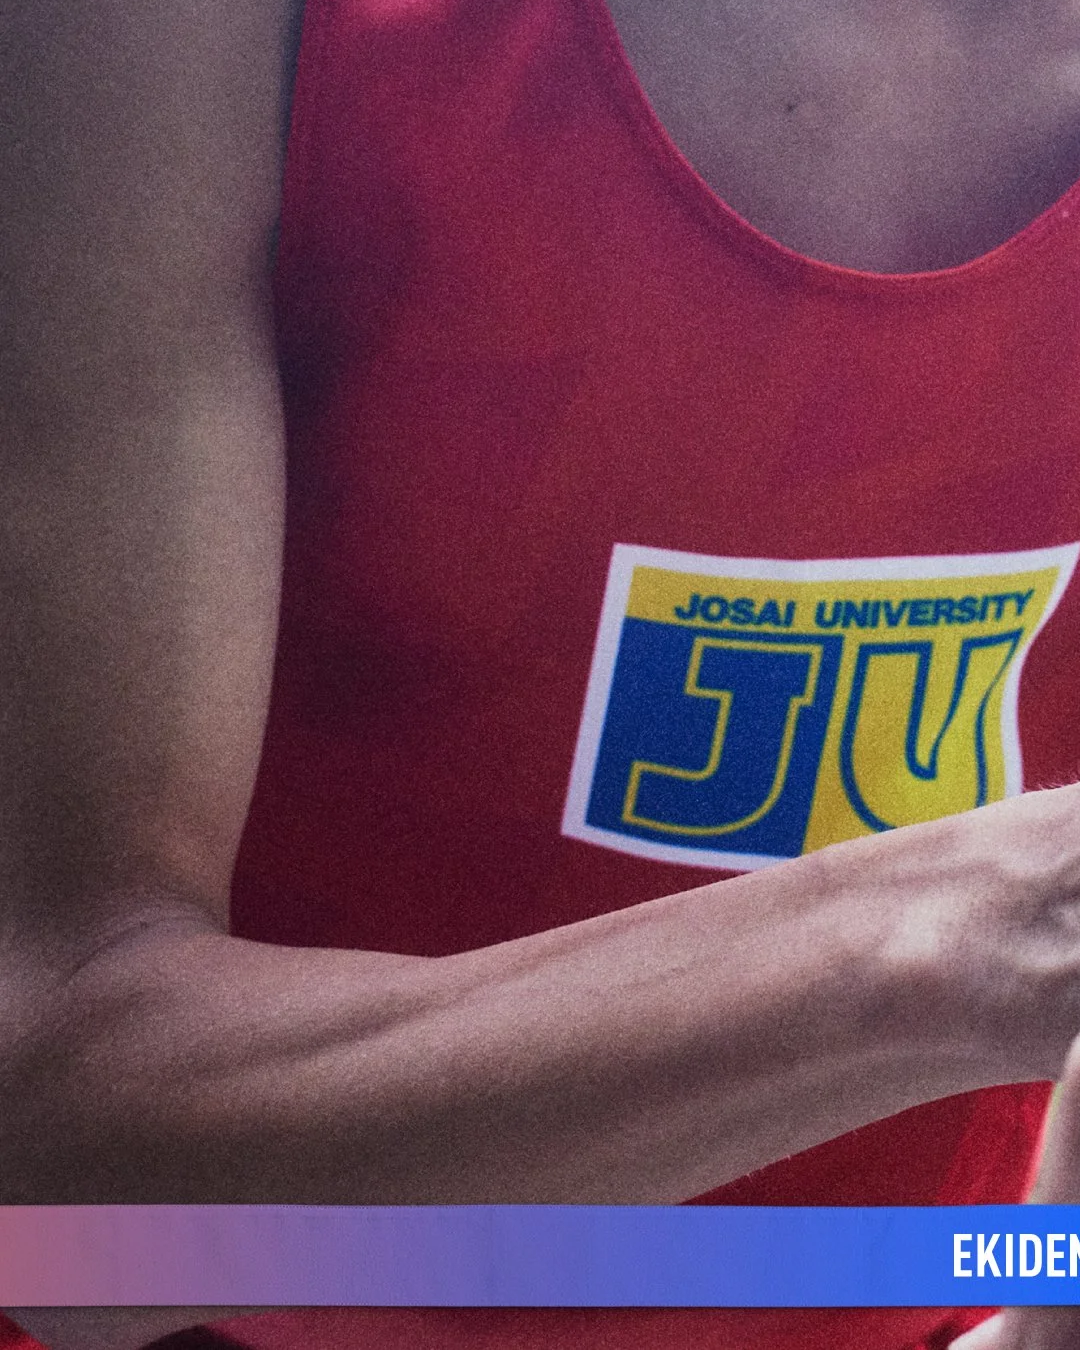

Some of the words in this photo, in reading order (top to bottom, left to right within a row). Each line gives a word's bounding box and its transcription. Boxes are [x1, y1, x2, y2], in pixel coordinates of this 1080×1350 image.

[674, 593, 797, 627] JOSAI
[814, 588, 1035, 629] UNIVERSITY
[621, 628, 1025, 836] JU
